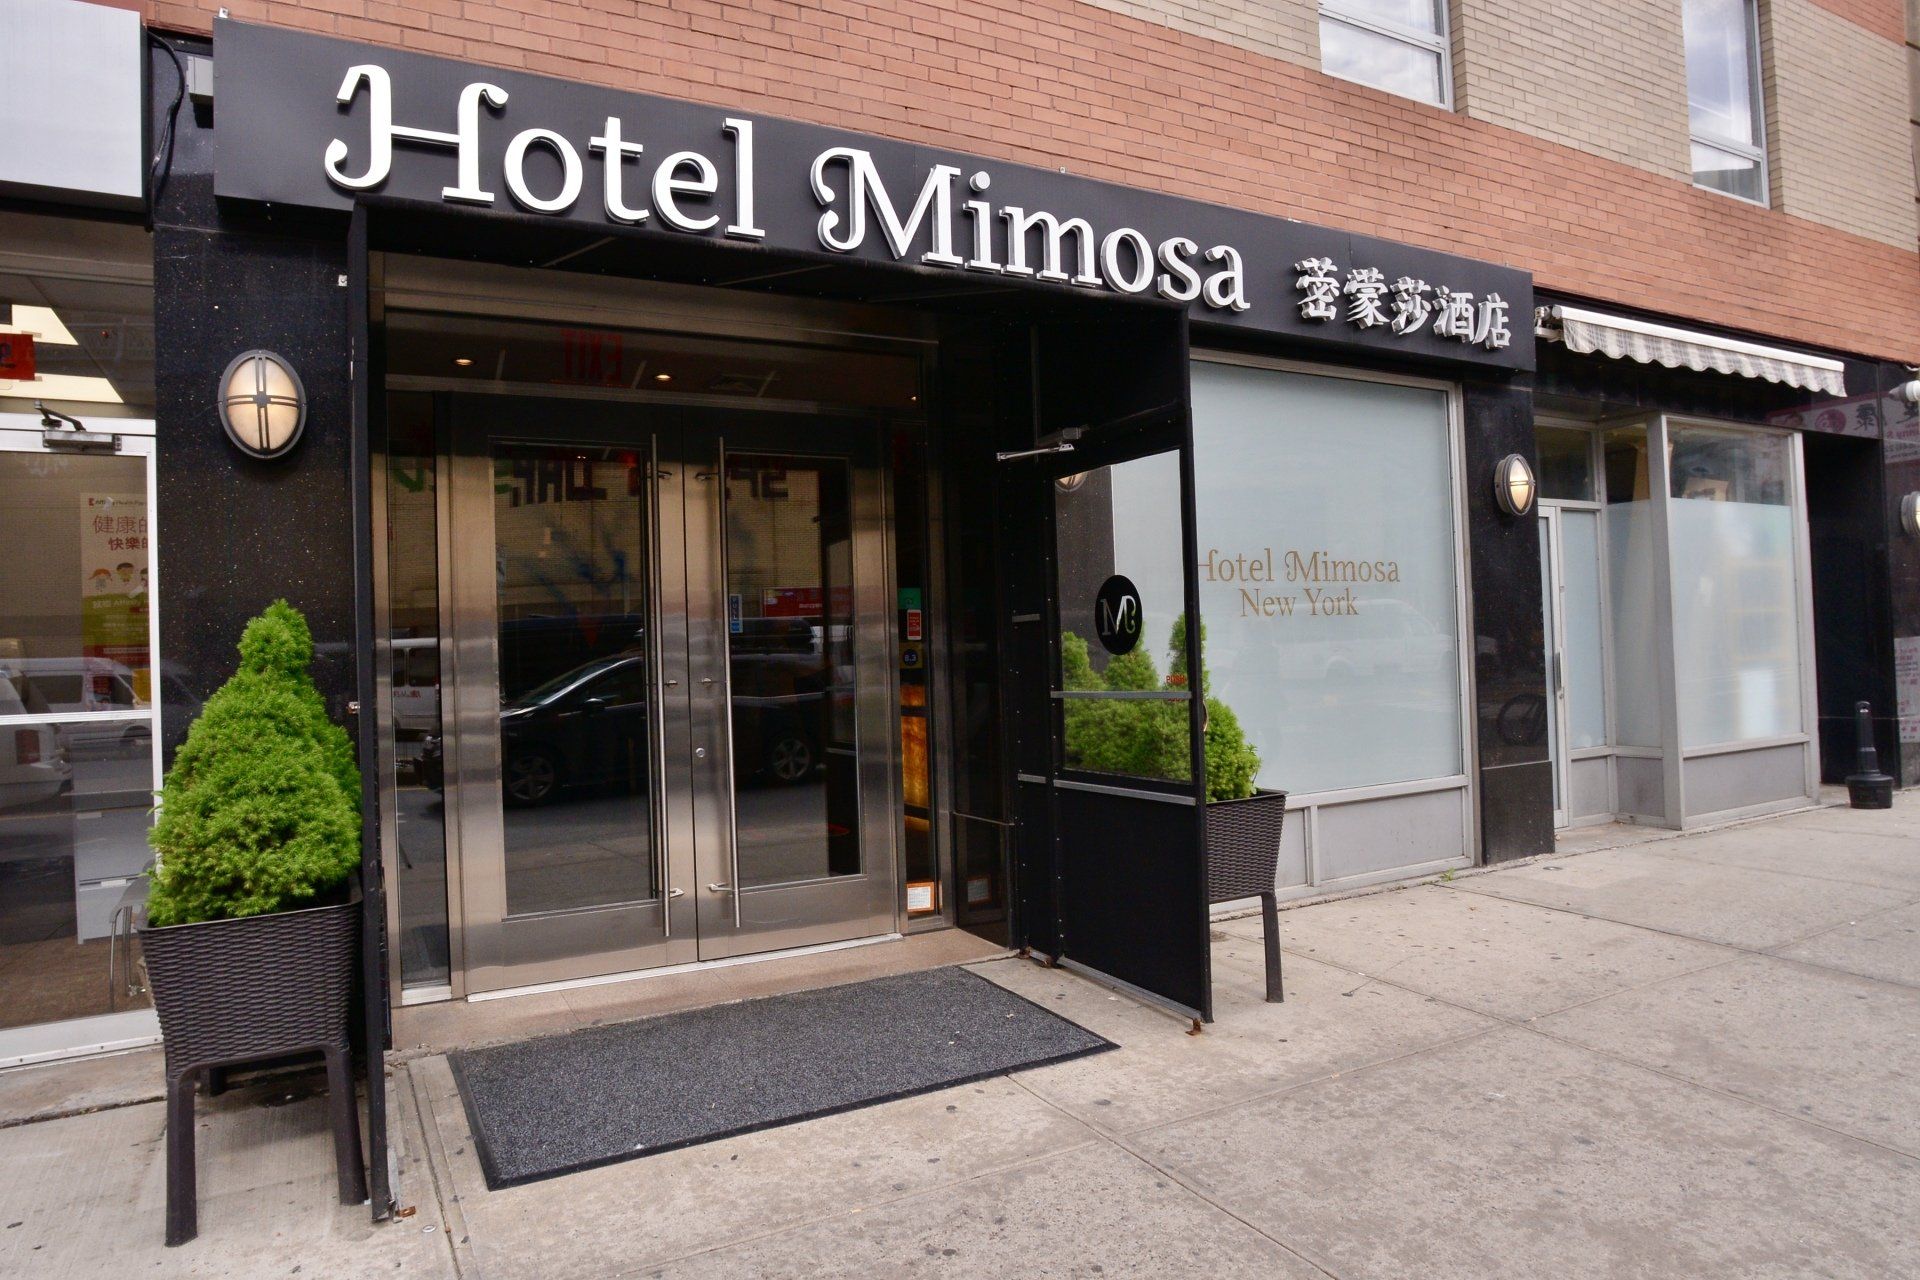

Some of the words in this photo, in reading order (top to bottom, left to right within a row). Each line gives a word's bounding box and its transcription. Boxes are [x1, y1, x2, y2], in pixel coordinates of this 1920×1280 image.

[323, 64, 768, 241] Hotel
[809, 145, 1252, 313] Mimosa
[1284, 550, 1400, 583] Mimosa
[1239, 588, 1297, 618] New
[1304, 587, 1360, 616] York
